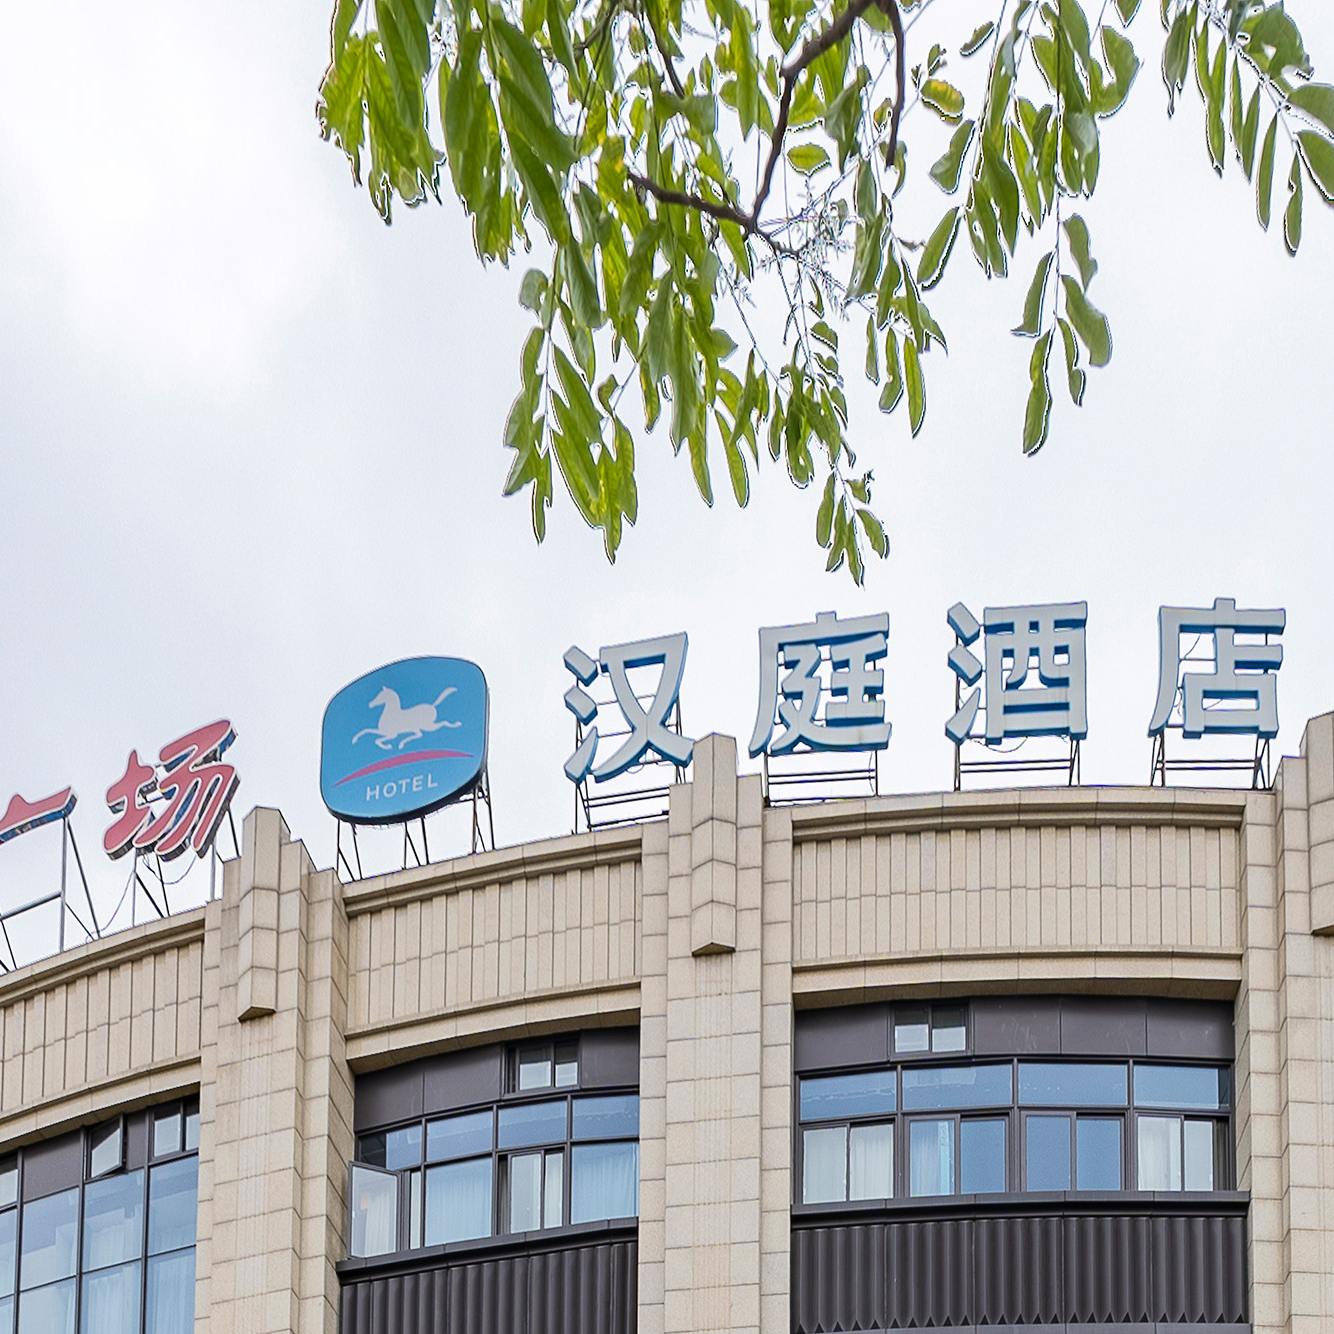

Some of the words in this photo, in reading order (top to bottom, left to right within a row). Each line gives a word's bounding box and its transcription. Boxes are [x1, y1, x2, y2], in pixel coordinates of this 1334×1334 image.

[563, 597, 1287, 784] 汉庭酒店
[365, 773, 439, 801] HOTEL
